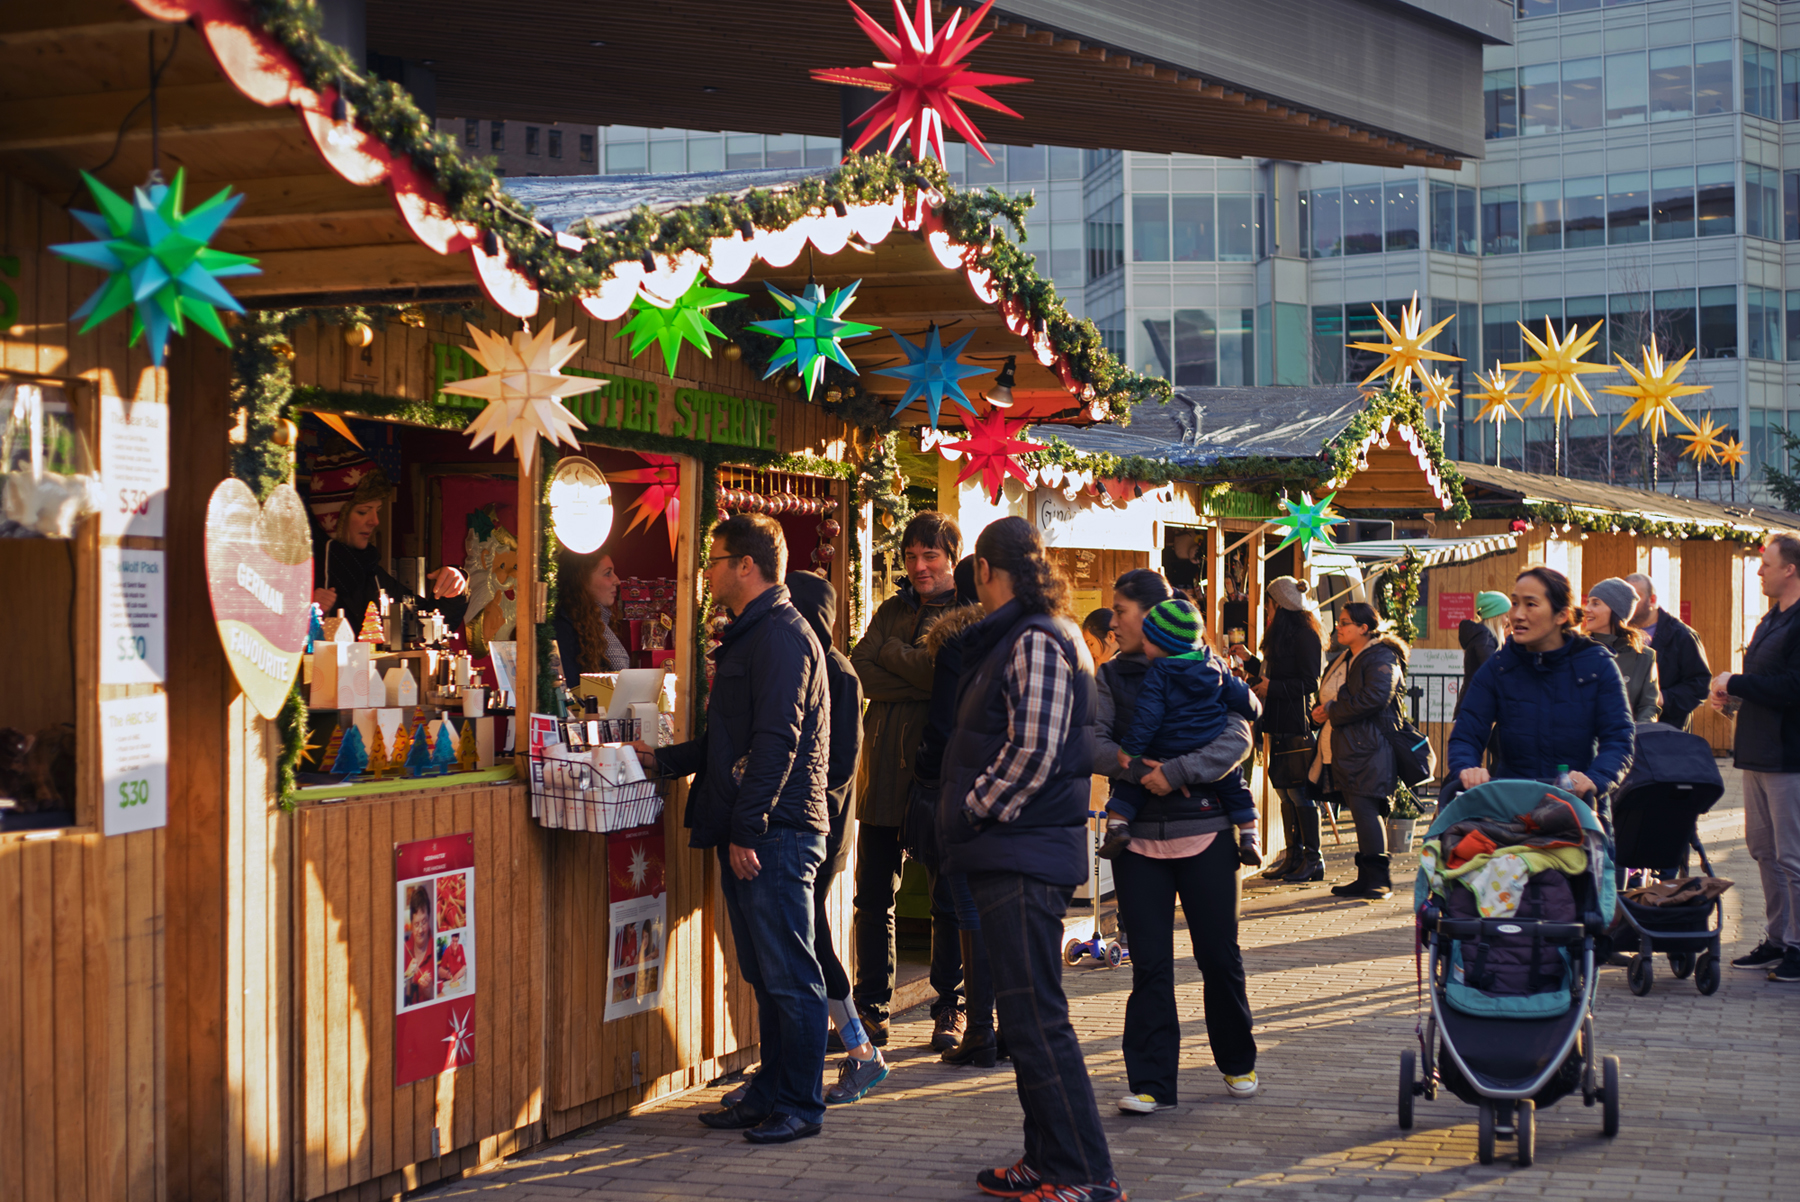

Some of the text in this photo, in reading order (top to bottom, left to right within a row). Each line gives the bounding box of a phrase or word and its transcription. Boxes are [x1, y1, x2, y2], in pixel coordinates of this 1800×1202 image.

[674, 386, 777, 450] STERNE
[119, 488, 149, 516] $30
[122, 561, 139, 573] Wolf
[141, 561, 159, 574] Pack
[237, 562, 284, 616] GERMAN
[117, 635, 147, 660] $30
[230, 626, 289, 682] FAVOURITE
[119, 779, 149, 809] $30
